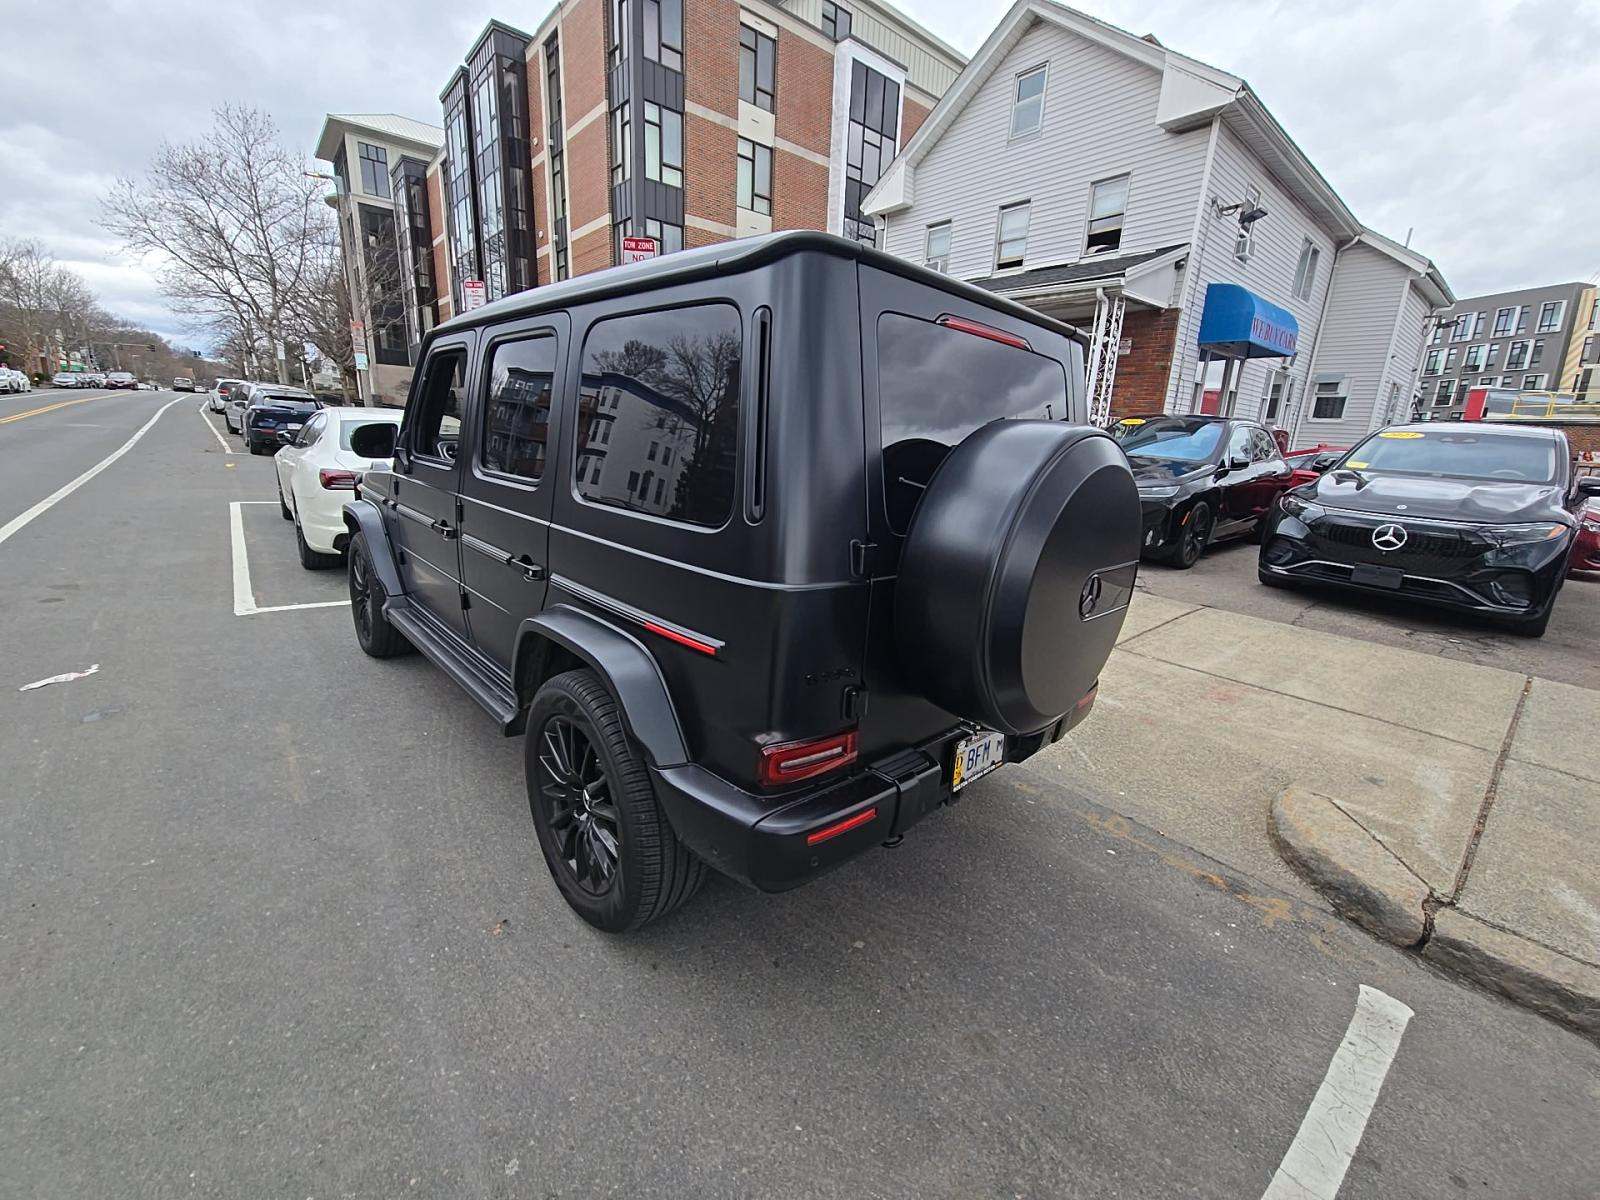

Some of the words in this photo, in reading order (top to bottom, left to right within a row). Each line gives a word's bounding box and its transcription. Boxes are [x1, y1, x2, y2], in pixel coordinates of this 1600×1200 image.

[624, 240, 636, 248] TOW
[638, 241, 654, 250] ZONE
[632, 254, 645, 262] NO
[966, 738, 991, 771] BFM
